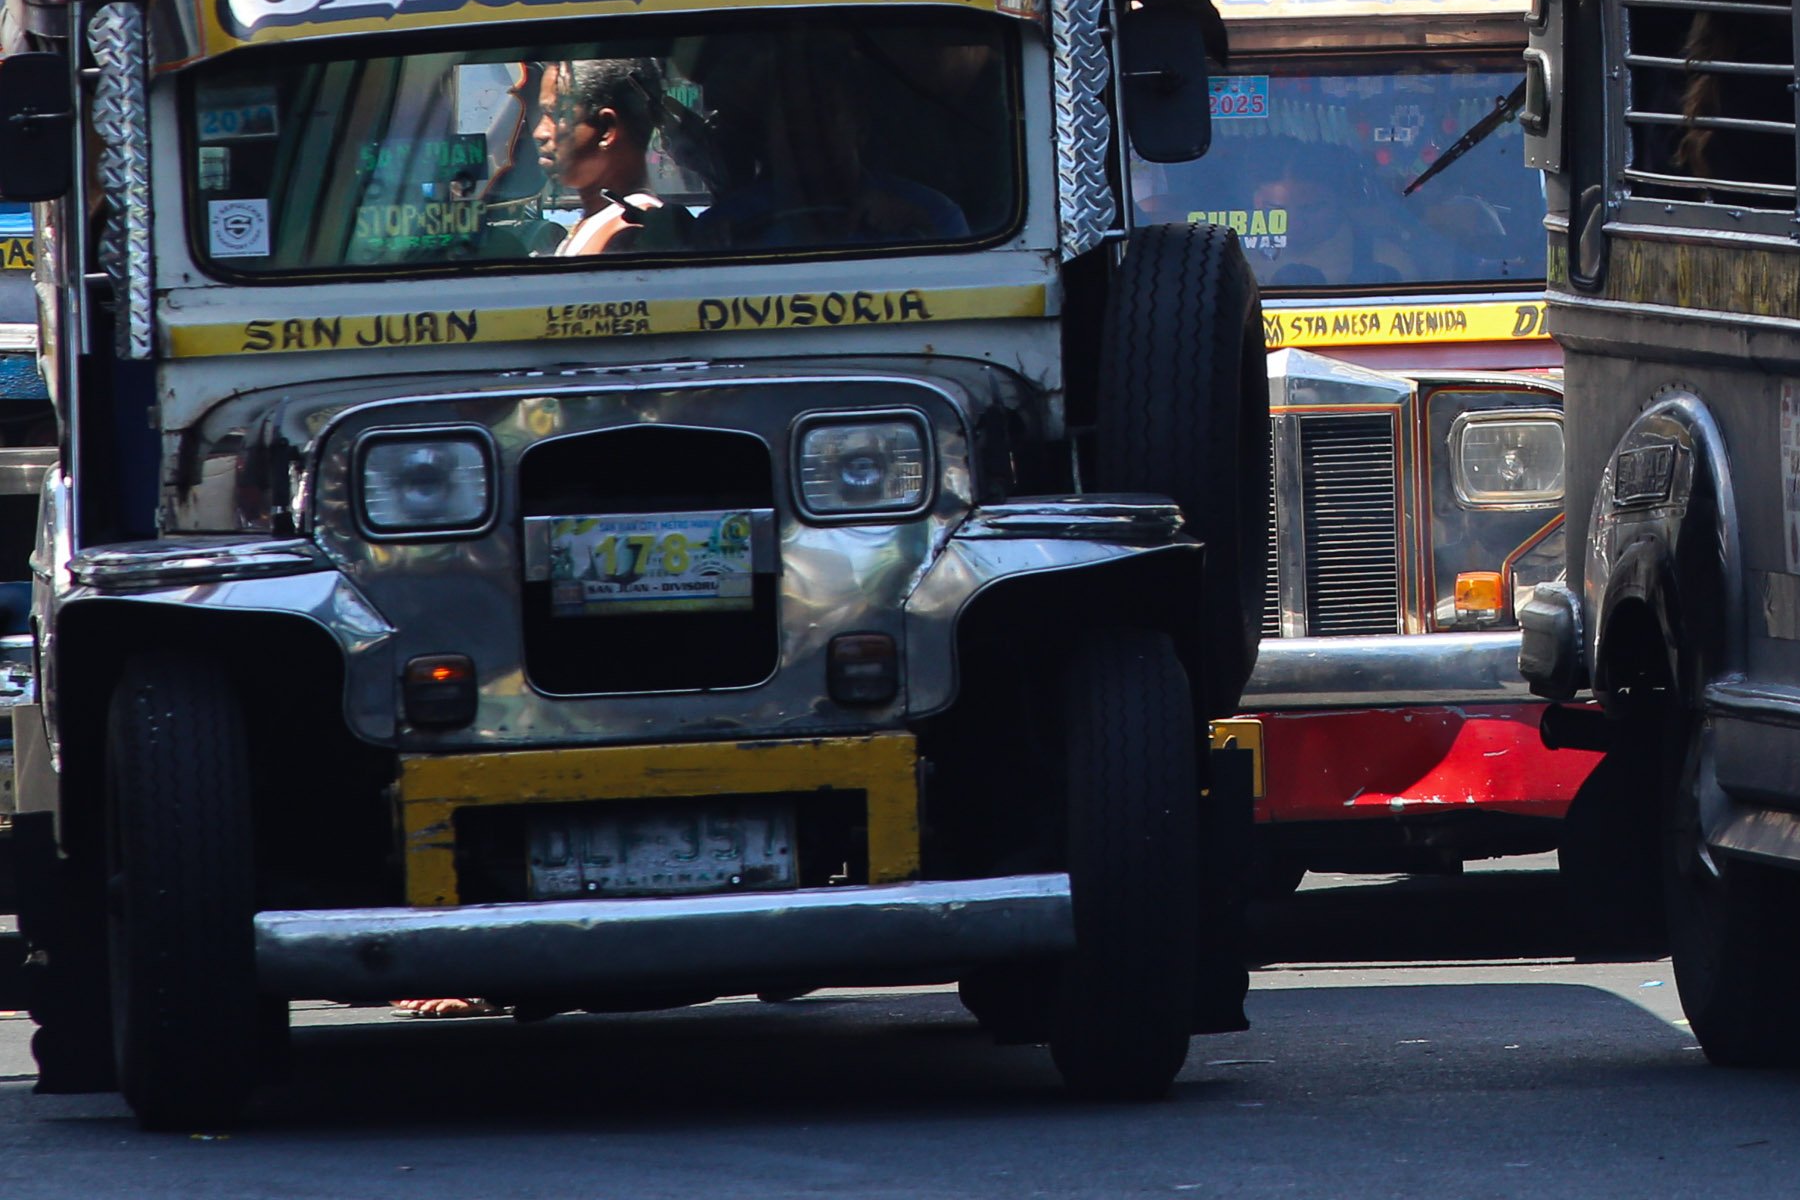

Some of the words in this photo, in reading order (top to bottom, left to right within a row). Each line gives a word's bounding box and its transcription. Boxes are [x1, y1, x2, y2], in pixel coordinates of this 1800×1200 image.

[1209, 95, 1265, 115] 2025
[0, 238, 36, 267] AS
[547, 300, 650, 322] LEGARDA
[697, 290, 935, 332] DIVISORIA
[1290, 314, 1328, 340] STA
[1331, 312, 1381, 338] MESA
[1388, 309, 1468, 339] AVENIDA
[242, 317, 342, 352] SAN
[354, 308, 481, 347] JUAN
[594, 533, 690, 576] 178
